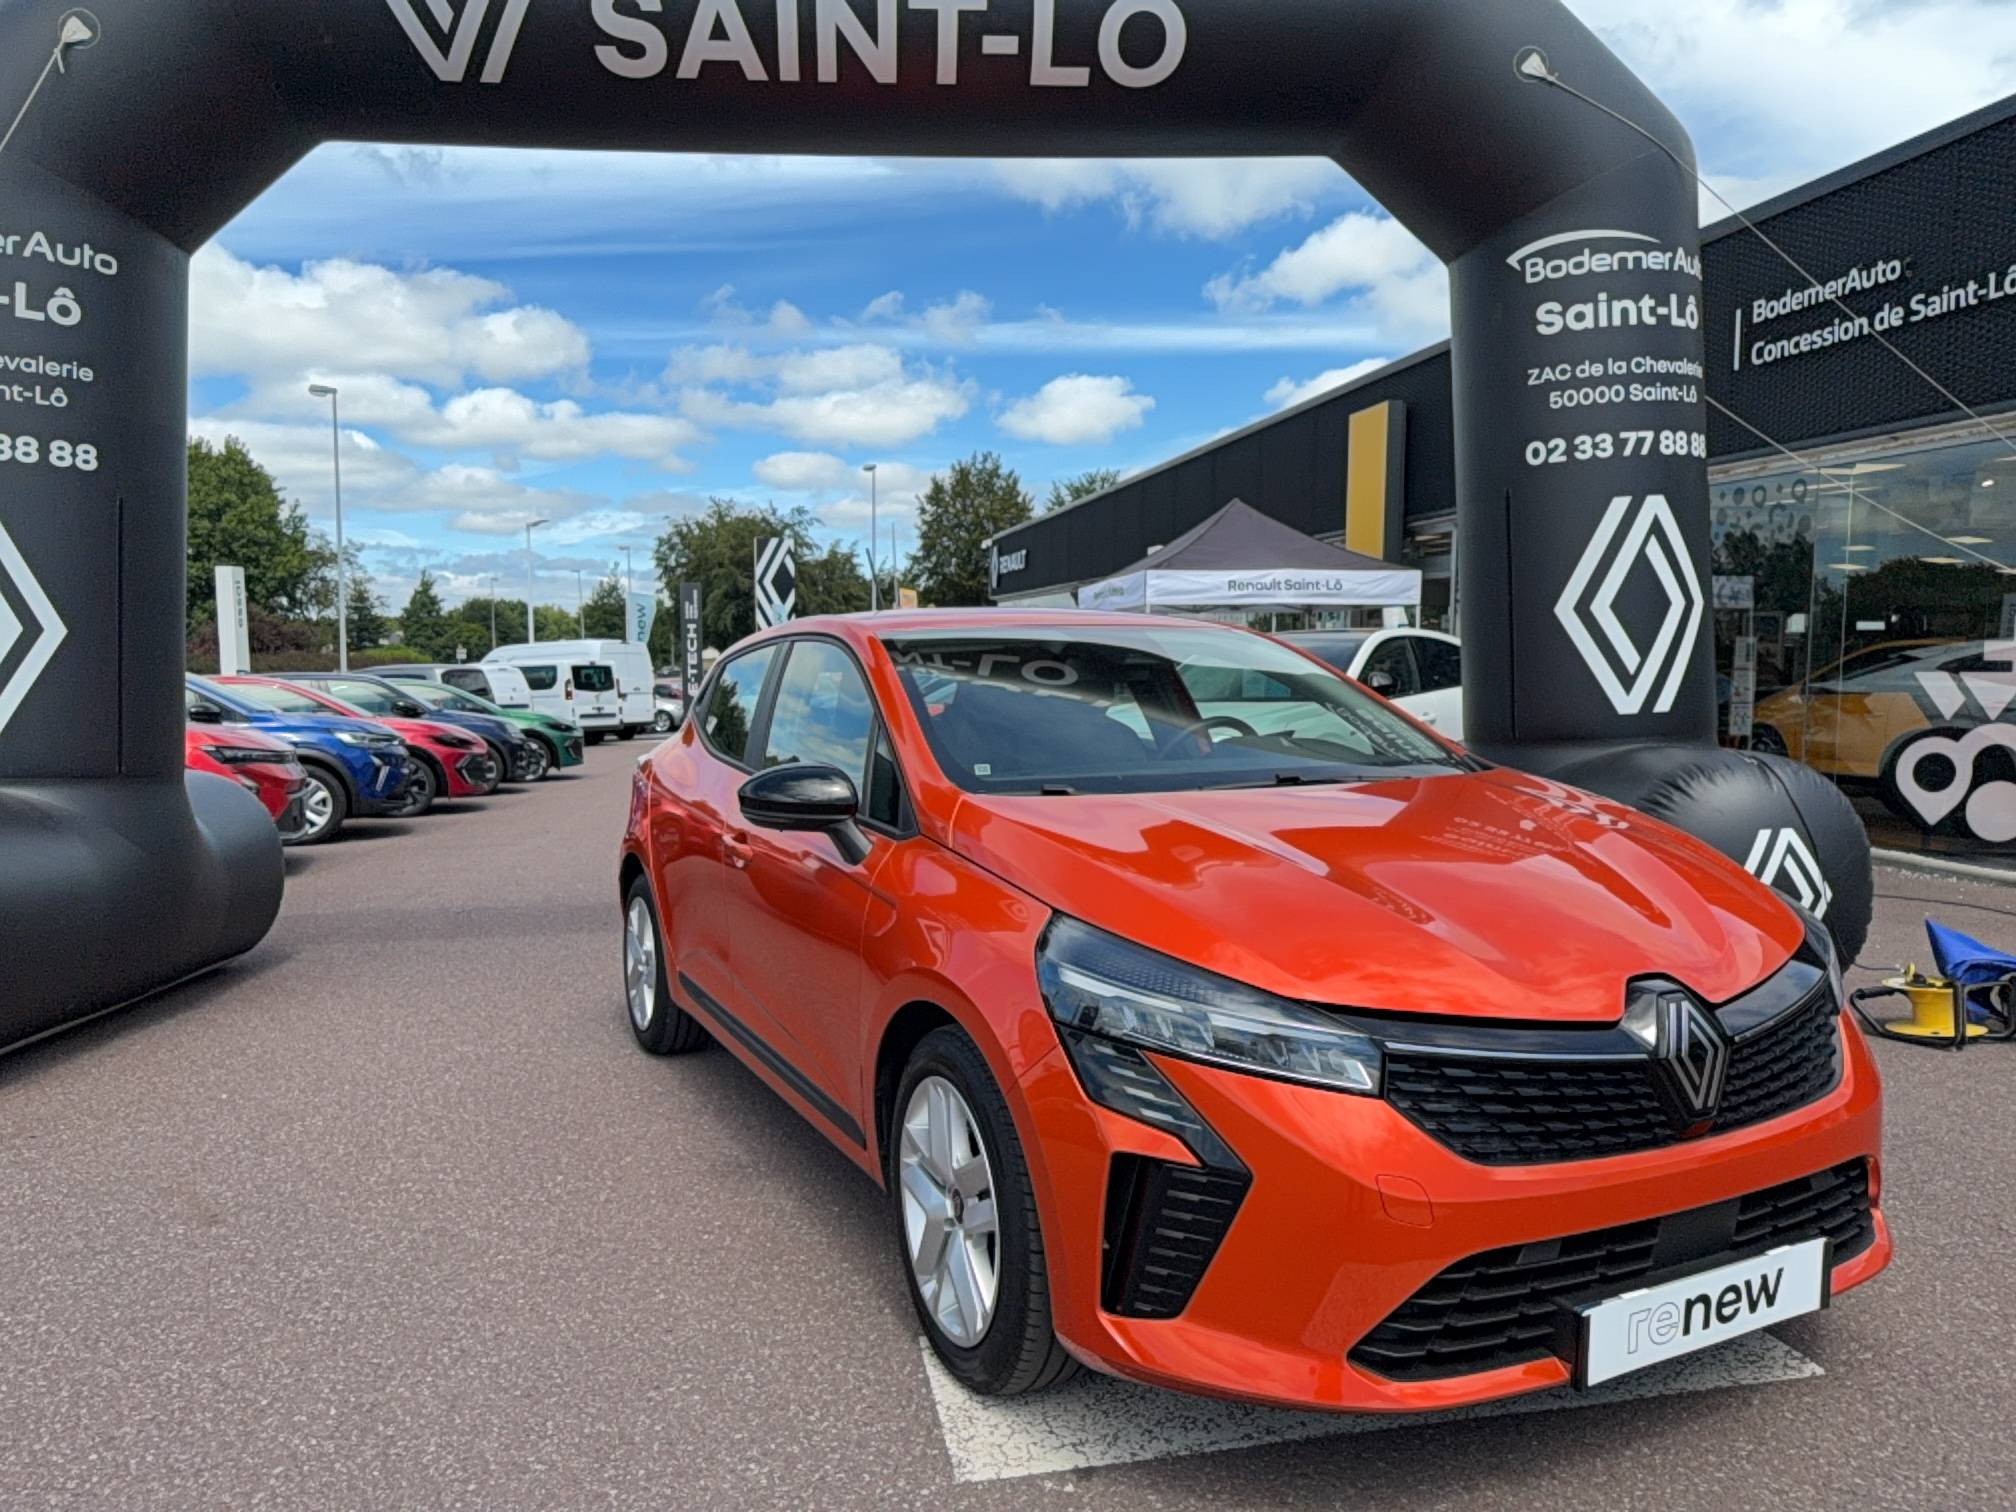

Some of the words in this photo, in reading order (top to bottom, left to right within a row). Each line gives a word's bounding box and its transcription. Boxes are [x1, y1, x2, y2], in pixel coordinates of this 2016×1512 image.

[0, 231, 118, 275] rAuto
[1752, 258, 1901, 324] BodemerAuto
[1535, 292, 1699, 336] Saint-Lô
[1751, 317, 1870, 366] Concession
[1873, 302, 1905, 332] de
[1909, 264, 2016, 323] Saint-Lô
[0, 355, 94, 382] valerie
[1527, 363, 1572, 386] ZAC
[1575, 360, 1604, 378] de
[1608, 357, 1628, 376] la
[1549, 384, 1626, 410] 50000
[1629, 382, 1698, 404] Saint-Lô
[48, 439, 99, 471] 88
[1525, 437, 1568, 466] 02
[1573, 432, 1614, 460] 33
[1619, 430, 1655, 457] 77
[1659, 429, 1688, 456] 88
[1227, 579, 1281, 592] Renault
[1284, 578, 1343, 592] Saint-Lô
[686, 623, 698, 696] E-TECH
[1626, 1266, 1785, 1355] renew
